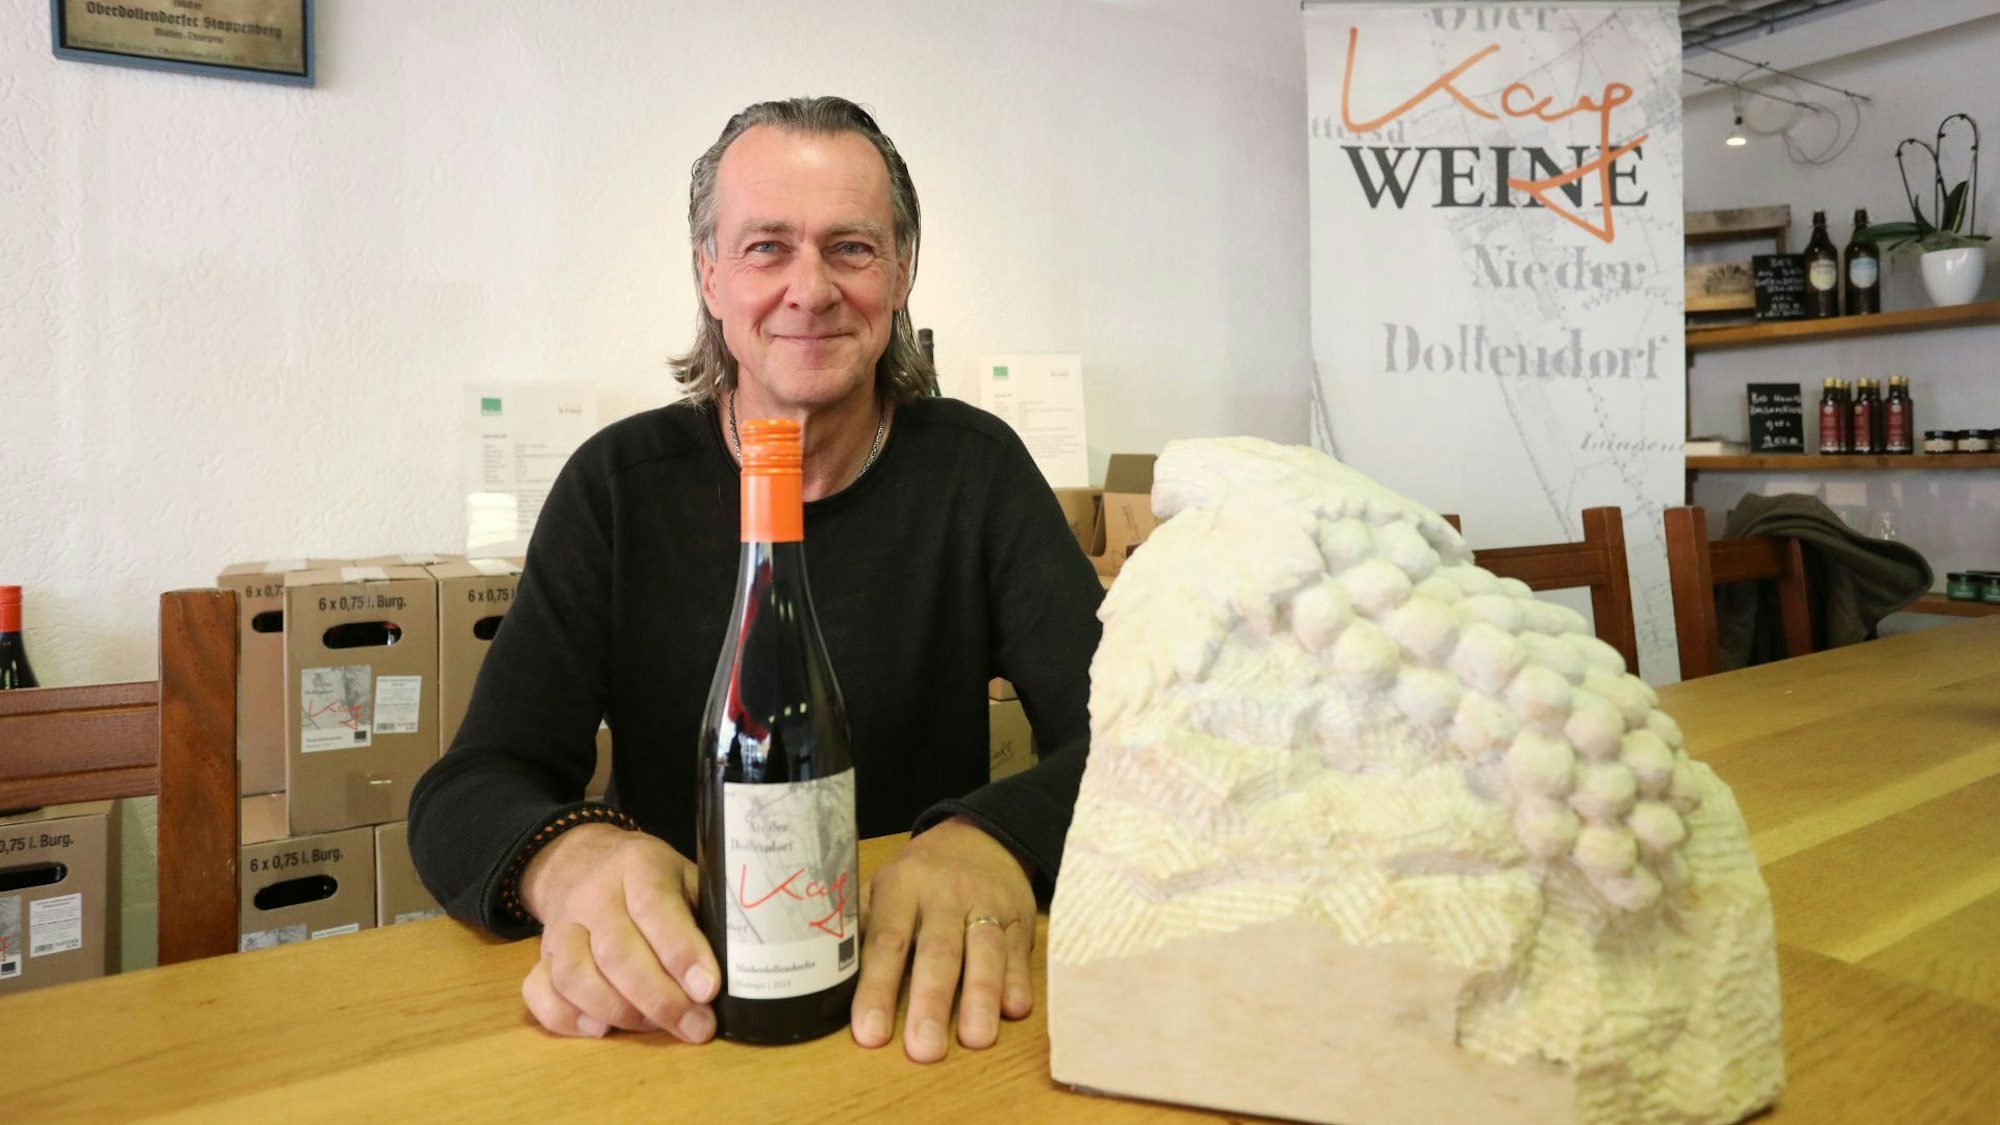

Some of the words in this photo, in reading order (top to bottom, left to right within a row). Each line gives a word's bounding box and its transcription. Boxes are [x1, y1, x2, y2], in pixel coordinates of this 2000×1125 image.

[1340, 145, 1649, 209] WEINE
[1471, 244, 1647, 291] Nieder
[1383, 322, 1670, 380] Dollendorf
[246, 585, 254, 598] 6
[256, 588, 263, 597] x
[264, 584, 285, 599] 0,7
[468, 589, 475, 602] 6
[478, 592, 484, 601] x
[486, 588, 509, 603] 0,75
[318, 598, 326, 611] 6
[330, 600, 337, 610] x
[339, 596, 365, 612] 0,75
[377, 594, 407, 610] Burg.
[40, 834, 74, 848] Burg.
[250, 859, 258, 872] 6
[262, 860, 269, 871] x
[272, 852, 299, 871] 0,75
[302, 850, 309, 864] l.
[312, 848, 344, 863] Burg.
